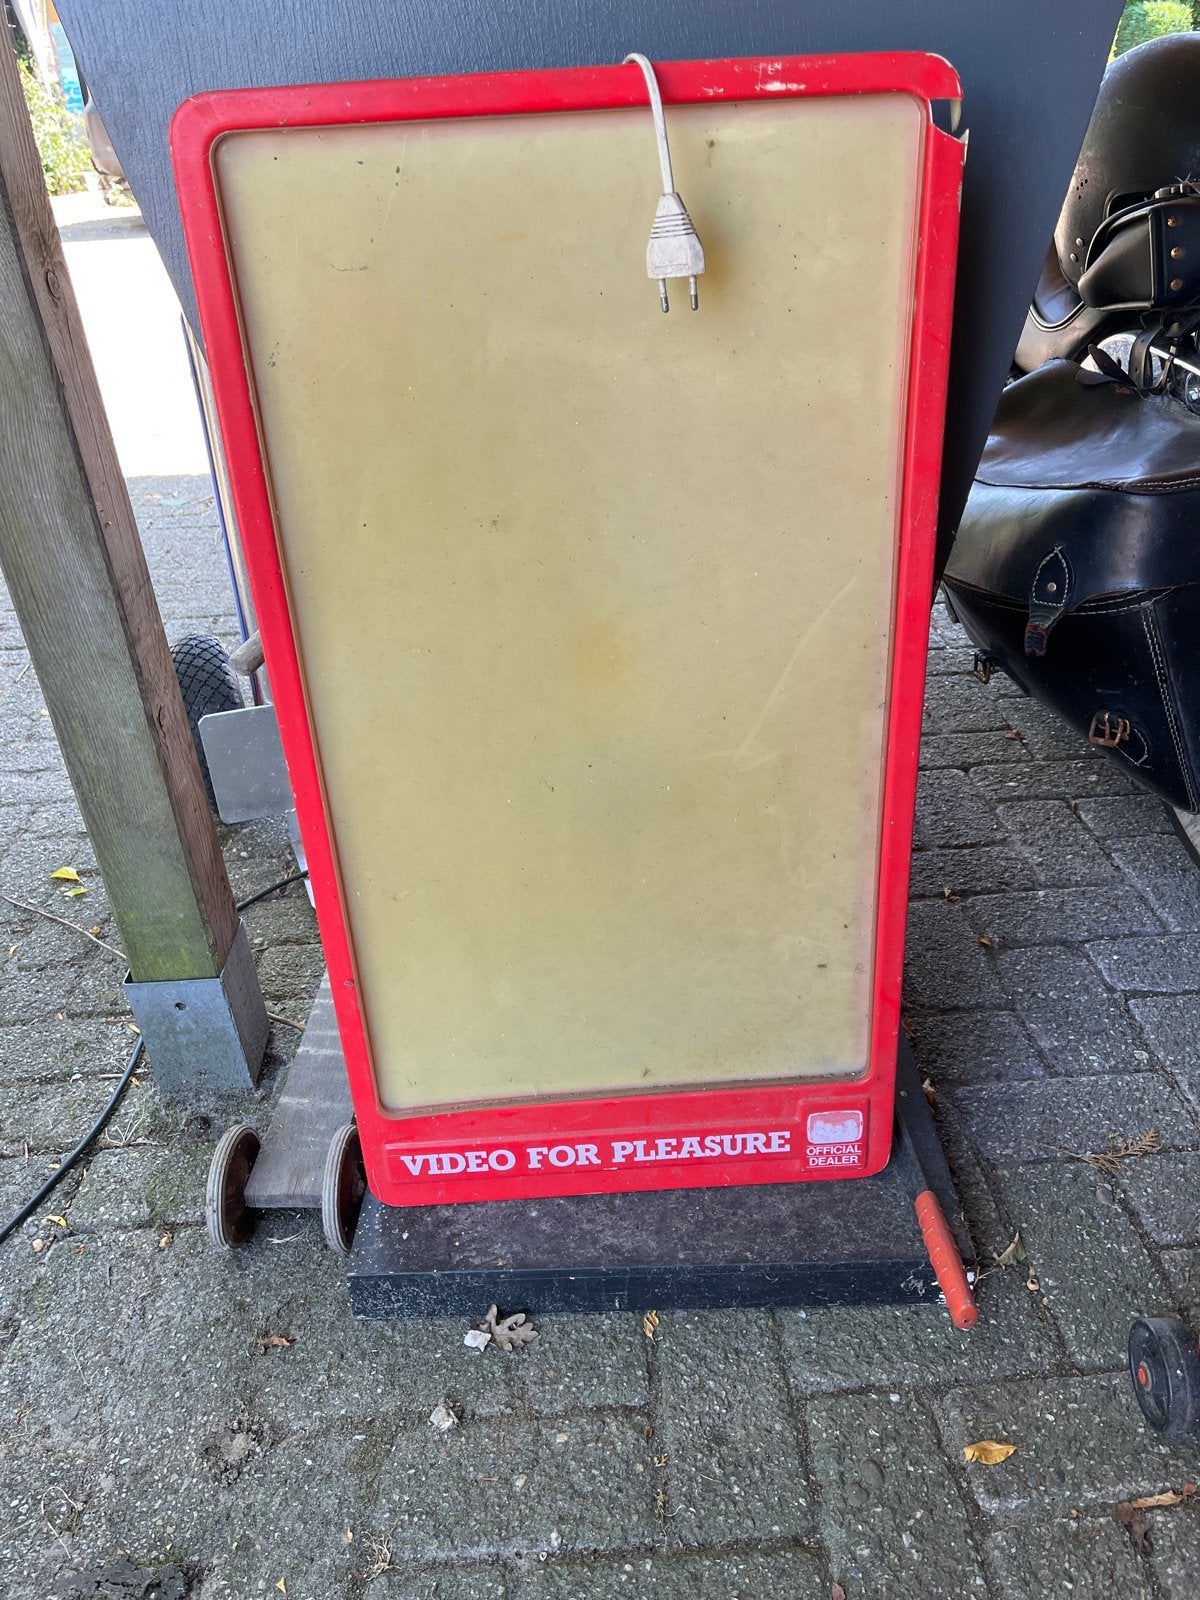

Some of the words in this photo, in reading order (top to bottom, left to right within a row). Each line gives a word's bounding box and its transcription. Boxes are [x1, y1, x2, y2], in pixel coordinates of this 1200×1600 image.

[400, 1149, 516, 1176] VIDEO
[526, 1143, 601, 1169] FOR
[611, 1131, 791, 1163] PLEASURE
[806, 1145, 862, 1156] OFFICIAL
[809, 1155, 858, 1166] DEALER
